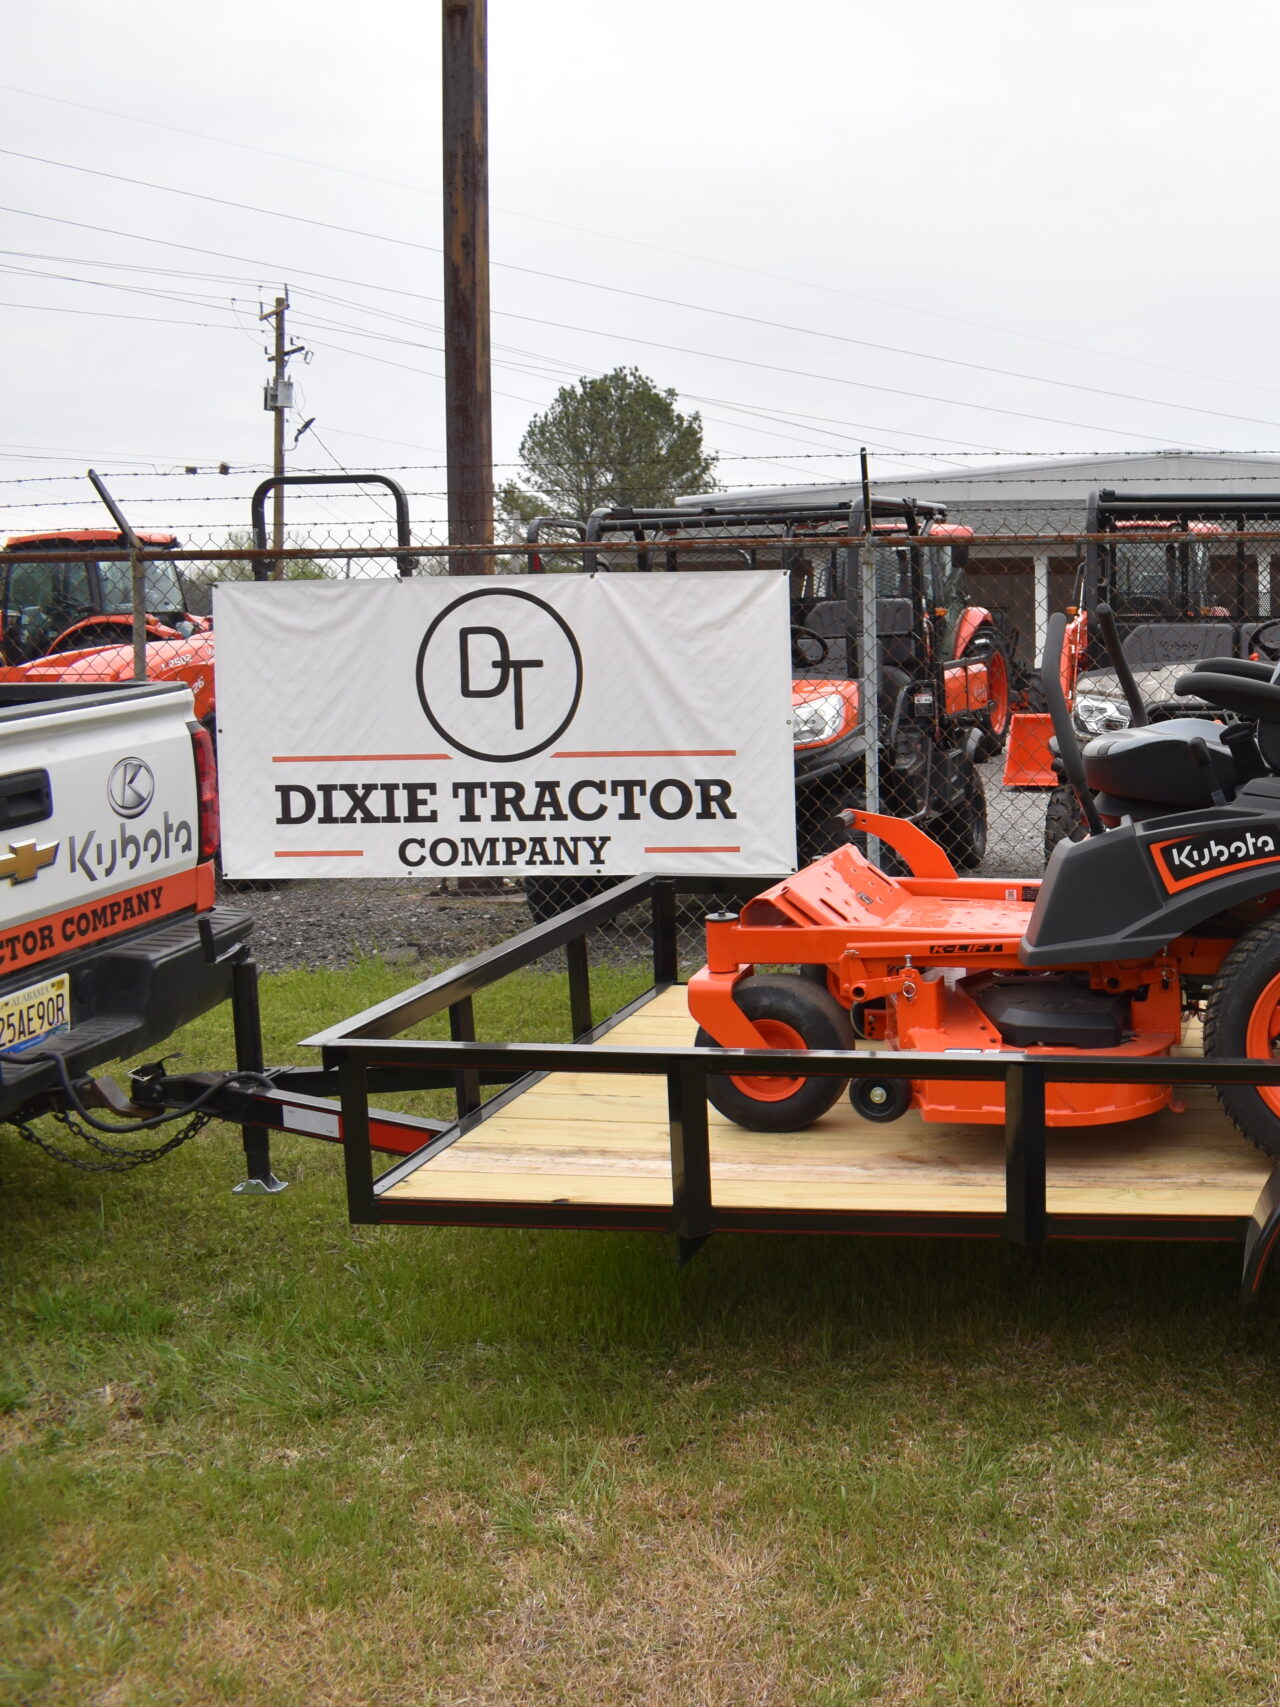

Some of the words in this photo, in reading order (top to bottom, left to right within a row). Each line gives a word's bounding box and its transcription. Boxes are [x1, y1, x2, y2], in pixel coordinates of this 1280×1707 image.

[276, 783, 438, 825] DIXIE
[453, 779, 738, 823] TRACTOR
[69, 811, 192, 882] Kubota
[398, 837, 612, 867] COMPANY
[1171, 832, 1275, 868] Kubota
[62, 886, 164, 942] COMPANY
[932, 944, 1002, 954] K-LIFT
